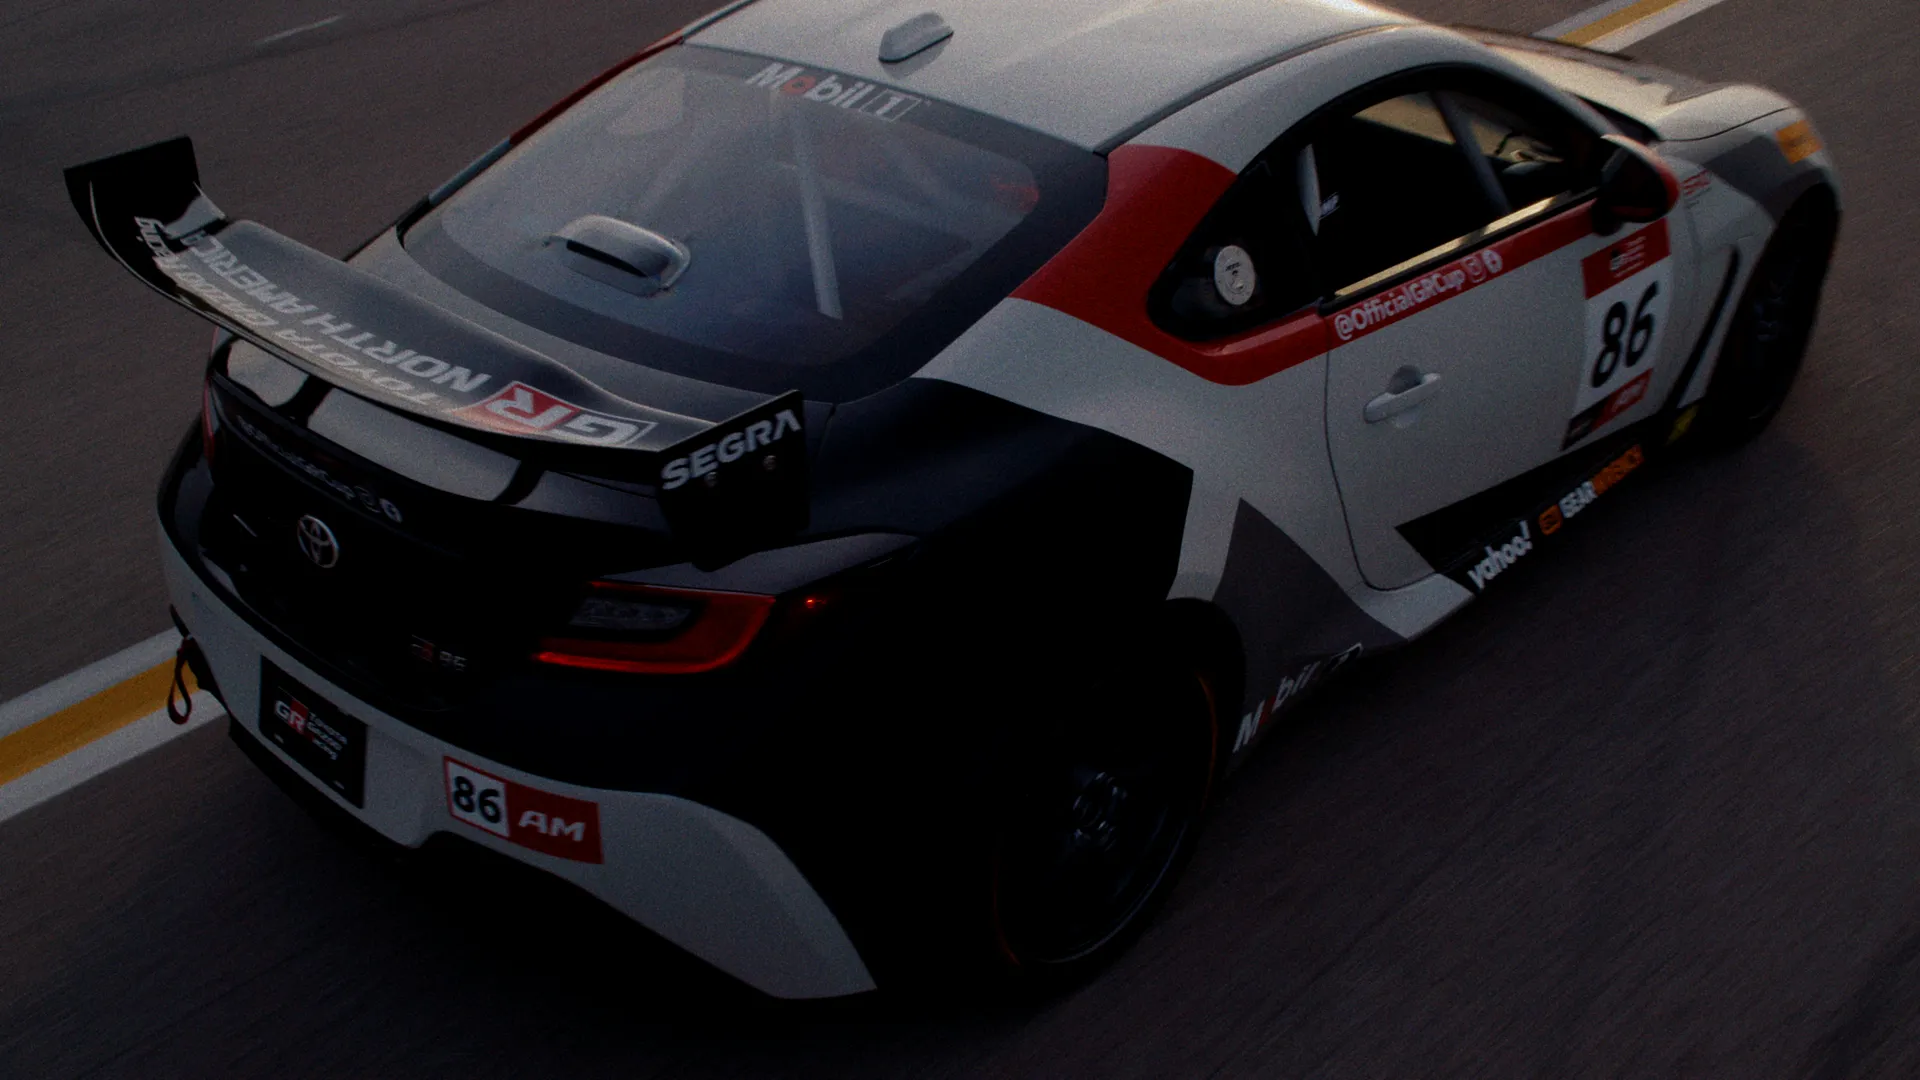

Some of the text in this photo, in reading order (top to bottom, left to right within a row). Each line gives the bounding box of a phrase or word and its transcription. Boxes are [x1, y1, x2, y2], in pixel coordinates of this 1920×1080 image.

[745, 62, 878, 108] Mobil
[180, 229, 492, 392] NORTH AMERICA
[1333, 267, 1467, 342] @OfficialGRCup
[1593, 281, 1657, 388] 86
[276, 328, 442, 406] TOYOTA
[490, 387, 642, 448] GR
[660, 408, 803, 491] SEGRA
[1466, 519, 1534, 590] yahoo!
[274, 699, 308, 735] GR
[1232, 660, 1321, 754] Mobil
[452, 775, 587, 843] 86 AM
